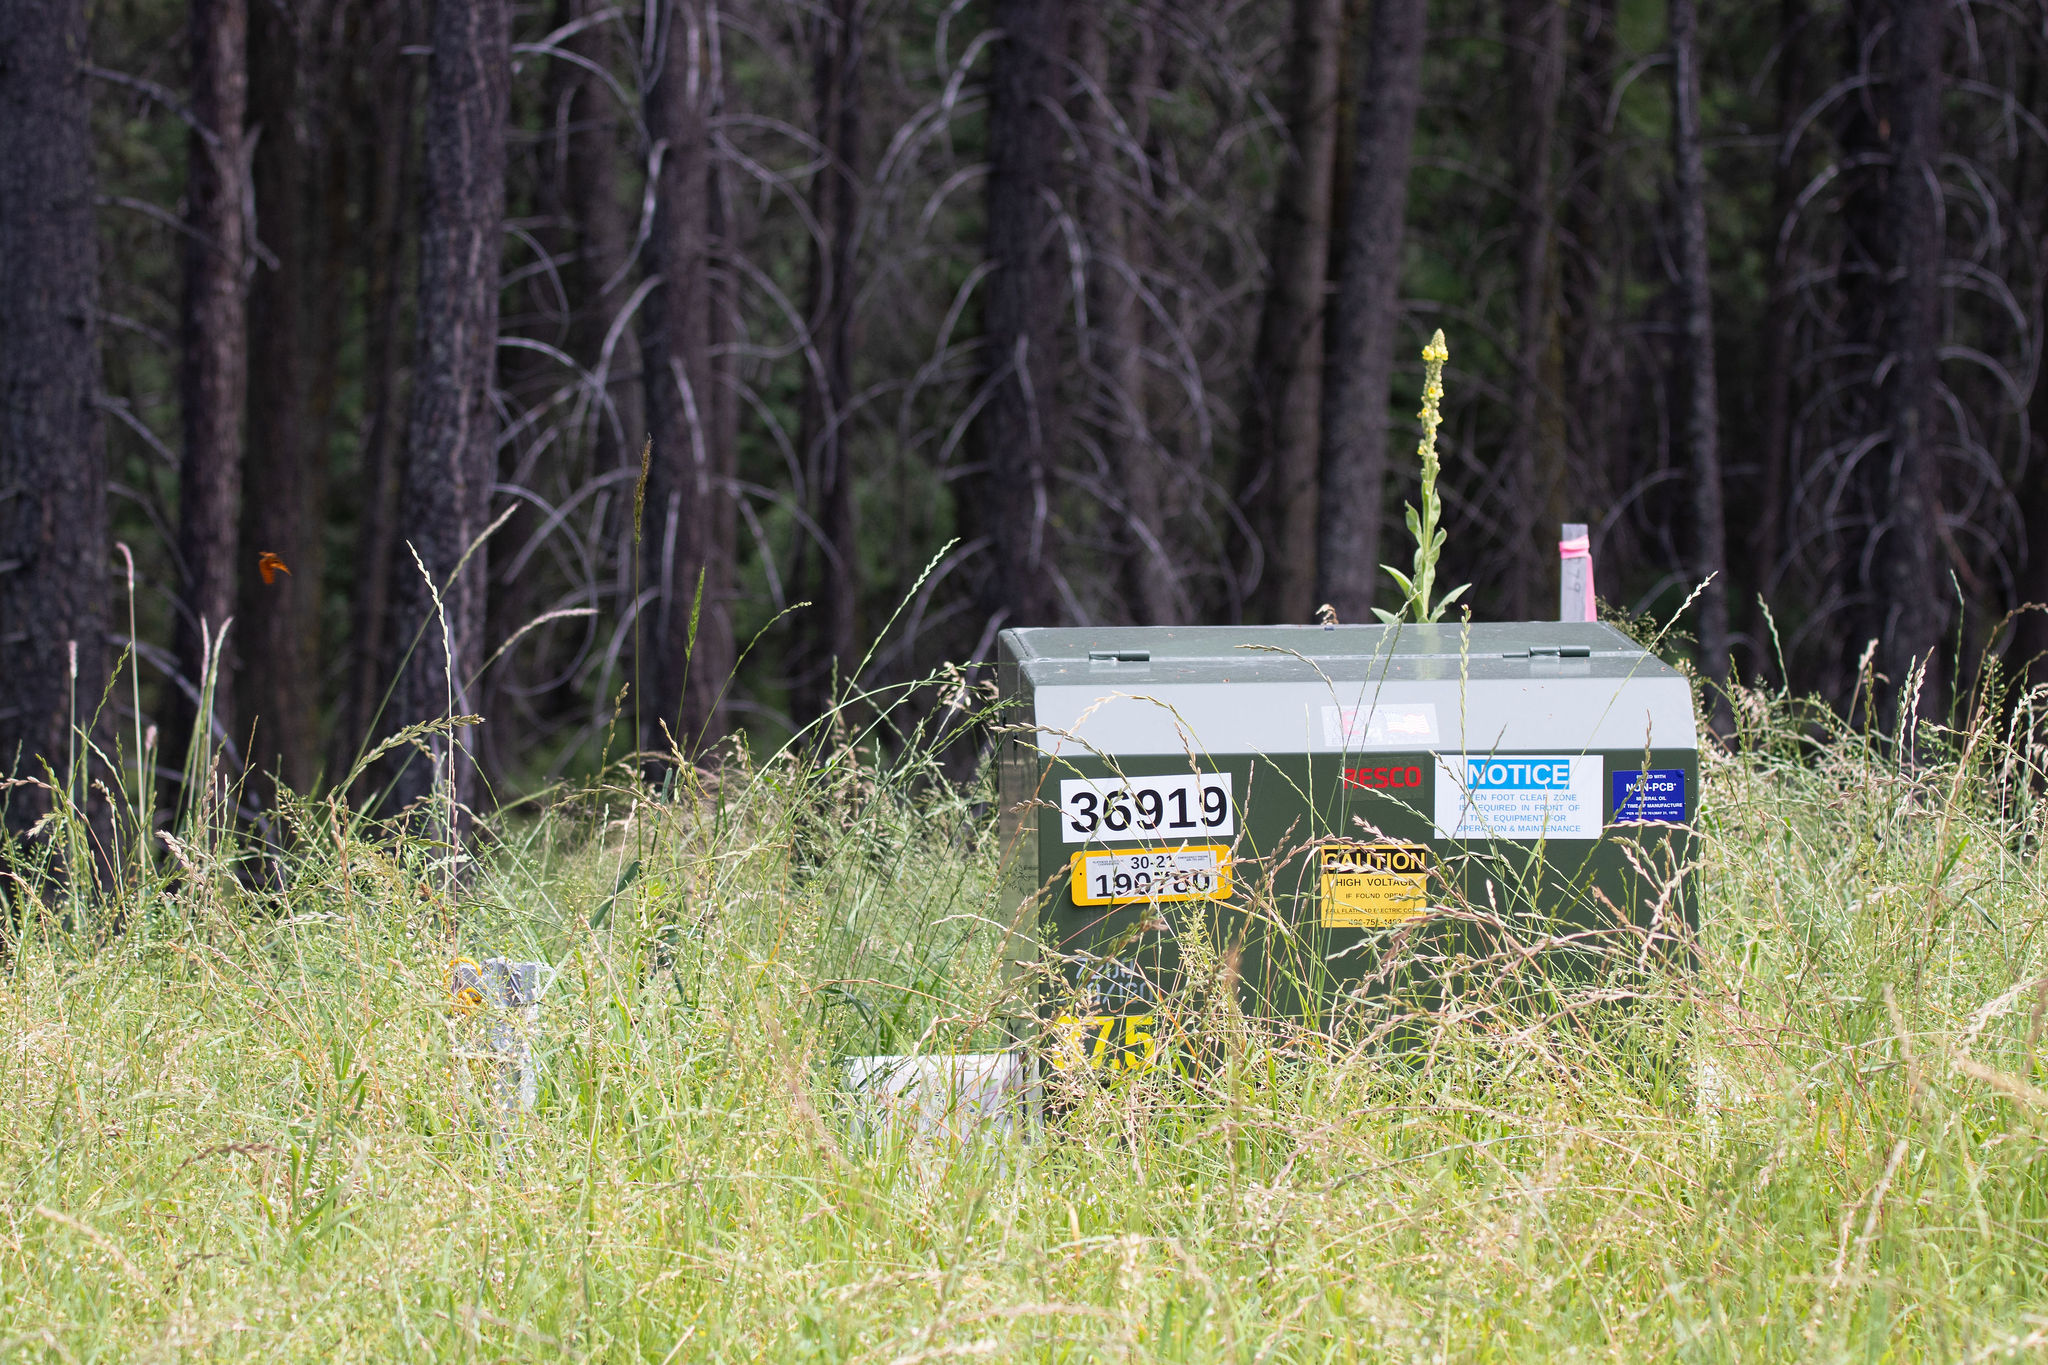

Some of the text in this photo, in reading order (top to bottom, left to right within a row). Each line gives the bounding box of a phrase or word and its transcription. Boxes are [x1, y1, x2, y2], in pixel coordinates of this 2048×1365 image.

[1343, 766, 1422, 789] RESCO
[1468, 764, 1569, 785] NOTICE
[1491, 793, 1515, 801] FOOT
[1553, 793, 1577, 801] ZONE
[1070, 786, 1227, 833] 36919
[1493, 814, 1544, 822] EQUIPMENT
[1518, 824, 1581, 832] MAINTENANCE
[1325, 852, 1426, 870] CAUTION
[1336, 878, 1361, 886] HIGH
